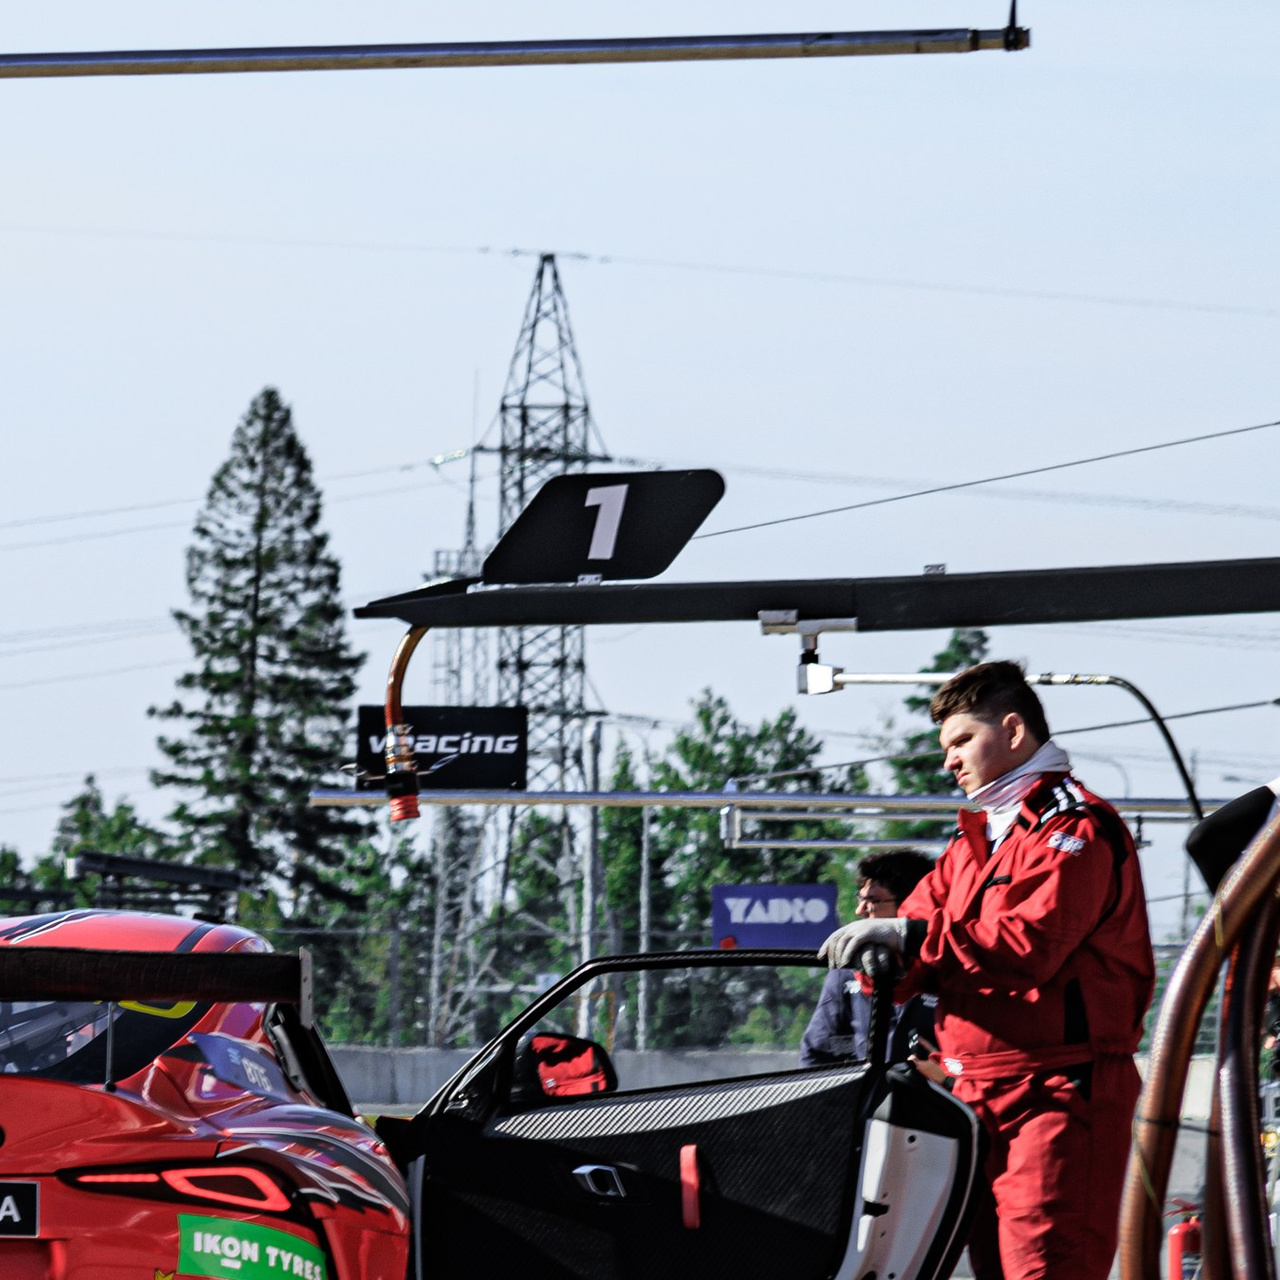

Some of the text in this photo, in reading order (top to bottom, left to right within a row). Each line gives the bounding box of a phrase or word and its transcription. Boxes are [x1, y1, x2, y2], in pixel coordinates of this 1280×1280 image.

[584, 483, 629, 560] 1
[369, 732, 519, 754] vacing
[724, 898, 829, 924] YADRO
[193, 1231, 259, 1270] IKON
